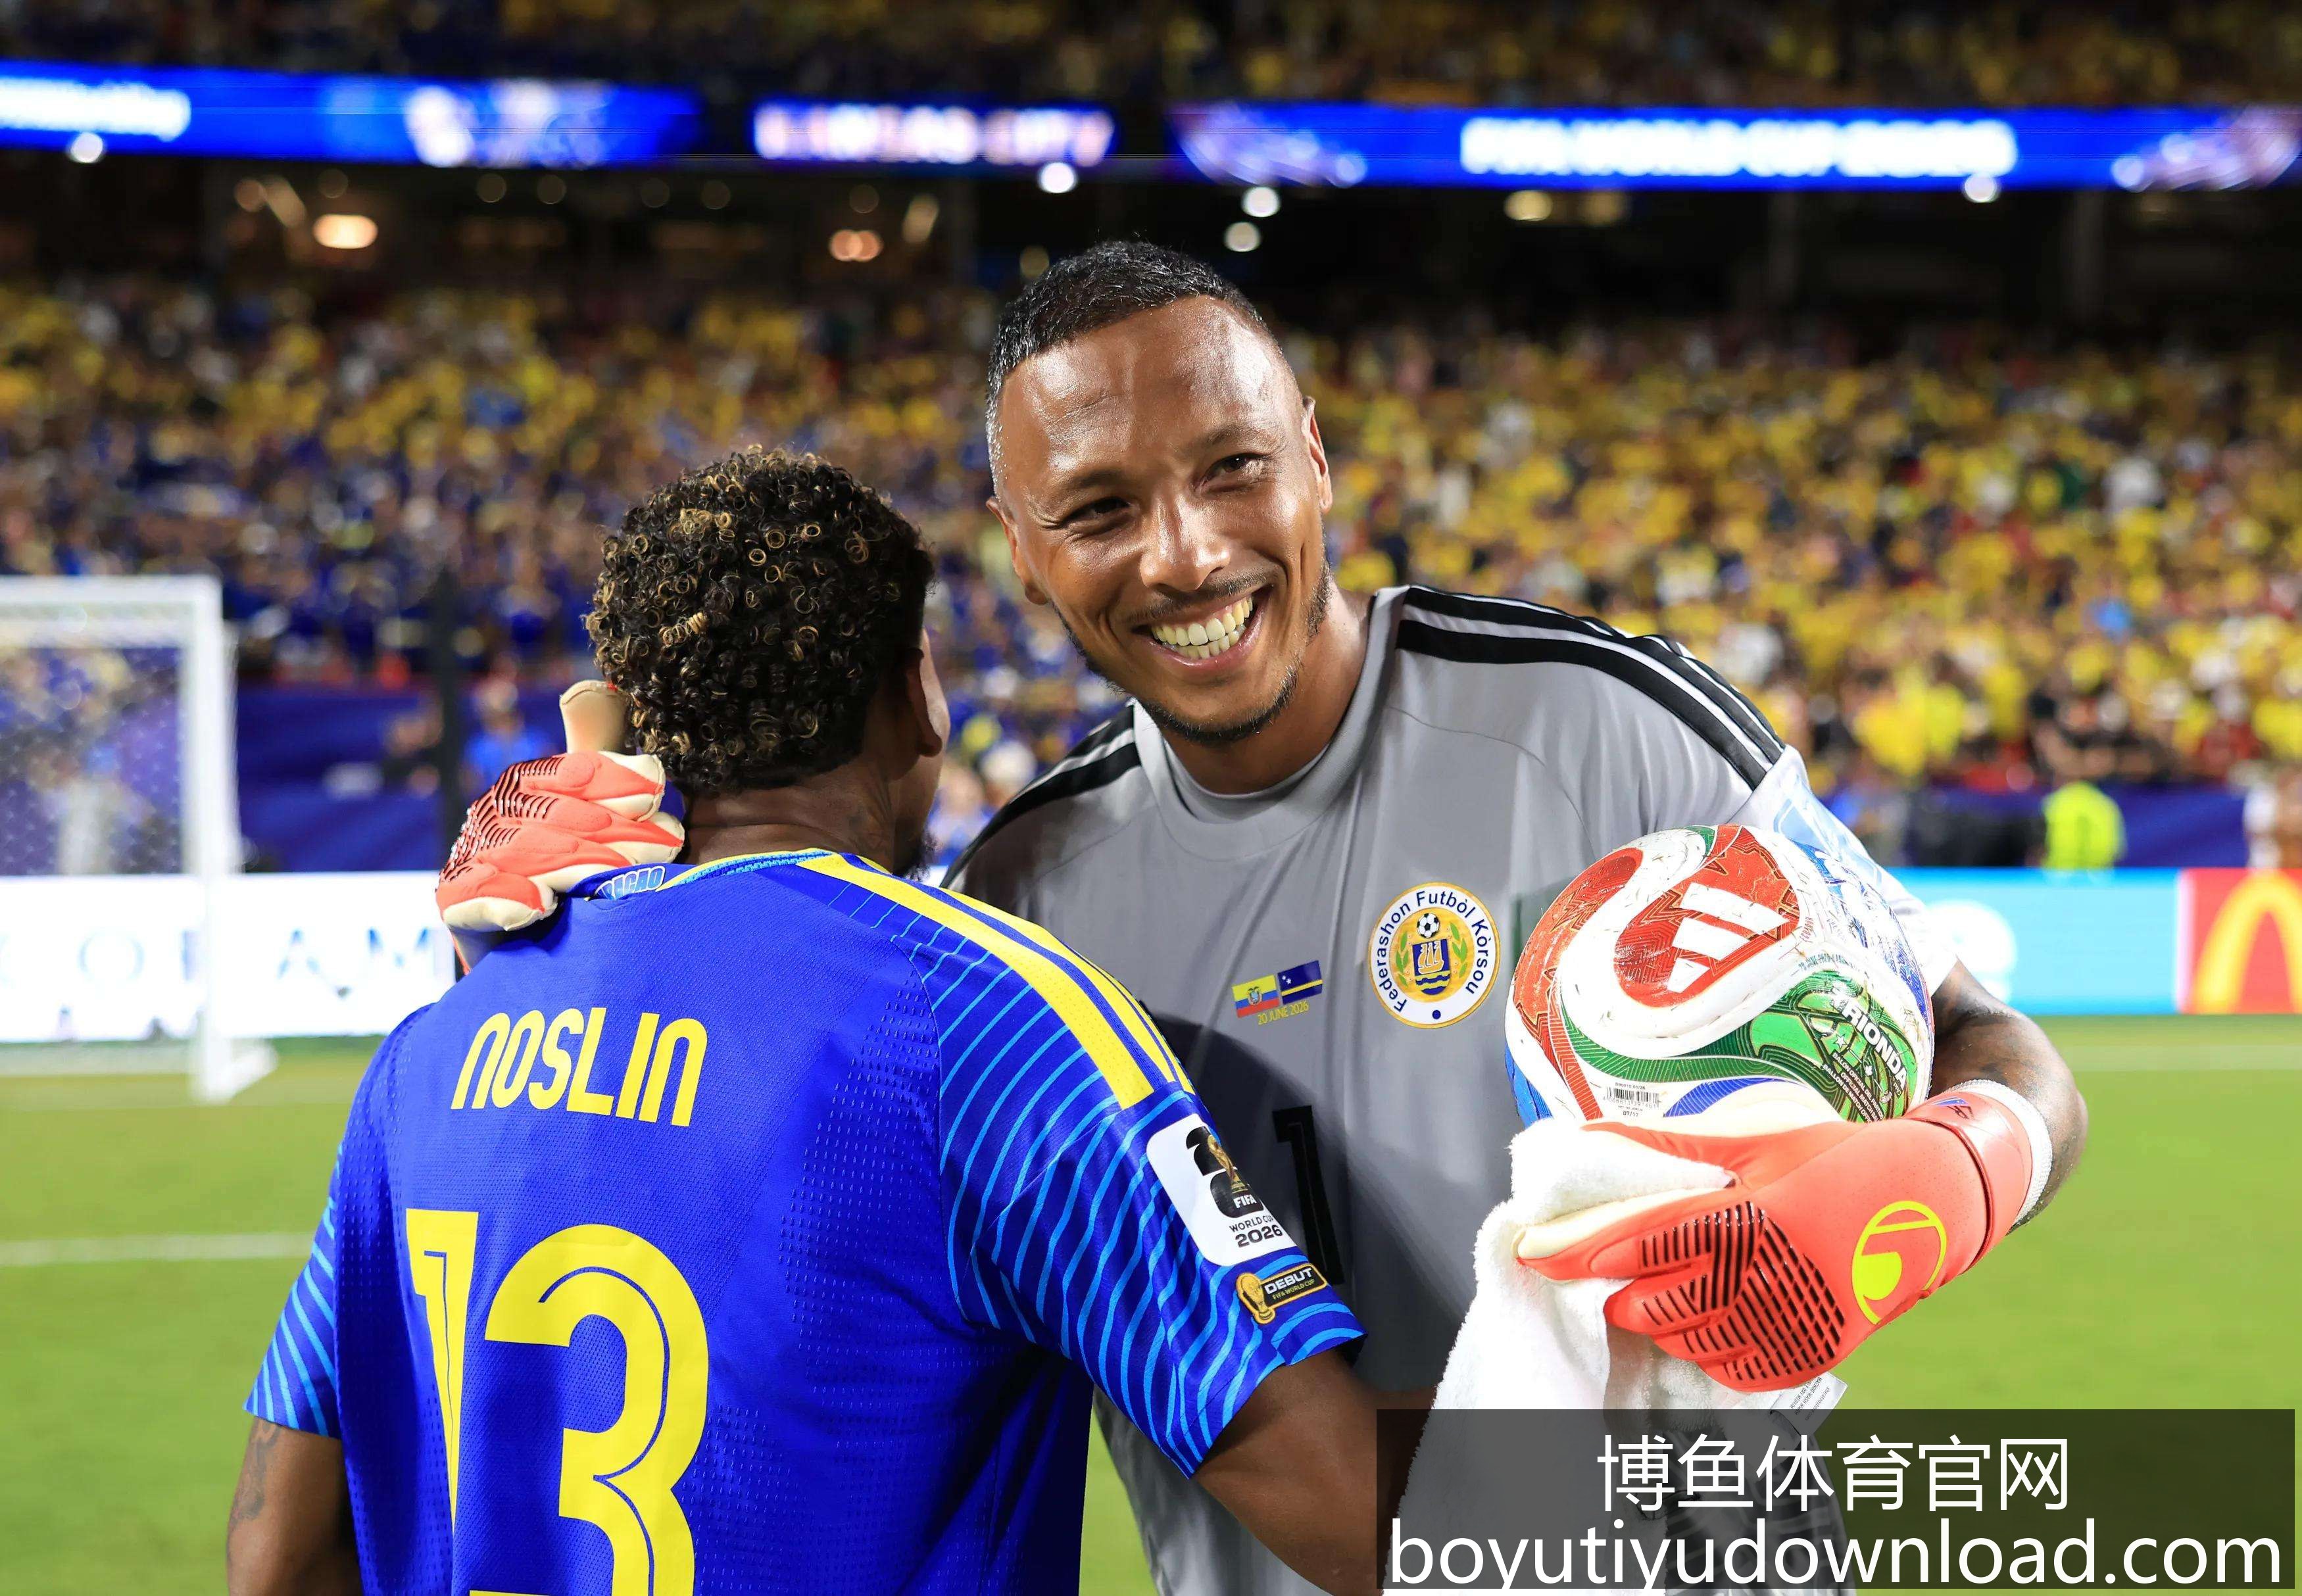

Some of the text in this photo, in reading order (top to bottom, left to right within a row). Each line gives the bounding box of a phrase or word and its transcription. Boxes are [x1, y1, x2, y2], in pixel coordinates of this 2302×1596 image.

[1377, 890, 1492, 1012] Federashon Futbòl Kòrsou
[1258, 1000, 1310, 1025] 20 JUNE 2026
[451, 1007, 708, 1127] NOSLIN
[1822, 1063, 1844, 1086] BALLON
[1842, 1084, 1850, 1093] DE
[1847, 1090, 1863, 1111] MATCH
[1840, 1071, 1861, 1096] OFFICIAL
[1858, 1094, 1874, 1113] MATCH
[1848, 1069, 1867, 1090] OFICIAL
[1864, 1088, 1873, 1100] DEL
[1870, 1098, 1884, 1119] PARTIDO
[1233, 1194, 1258, 1208] FIFA
[1229, 1217, 1262, 1232] WORLD
[1235, 1224, 1283, 1247] 2026
[1264, 1267, 1312, 1294] DEBUT
[1272, 1292, 1286, 1300] FIFA
[1285, 1284, 1305, 1295] WORLD
[406, 1207, 709, 1596] 13
